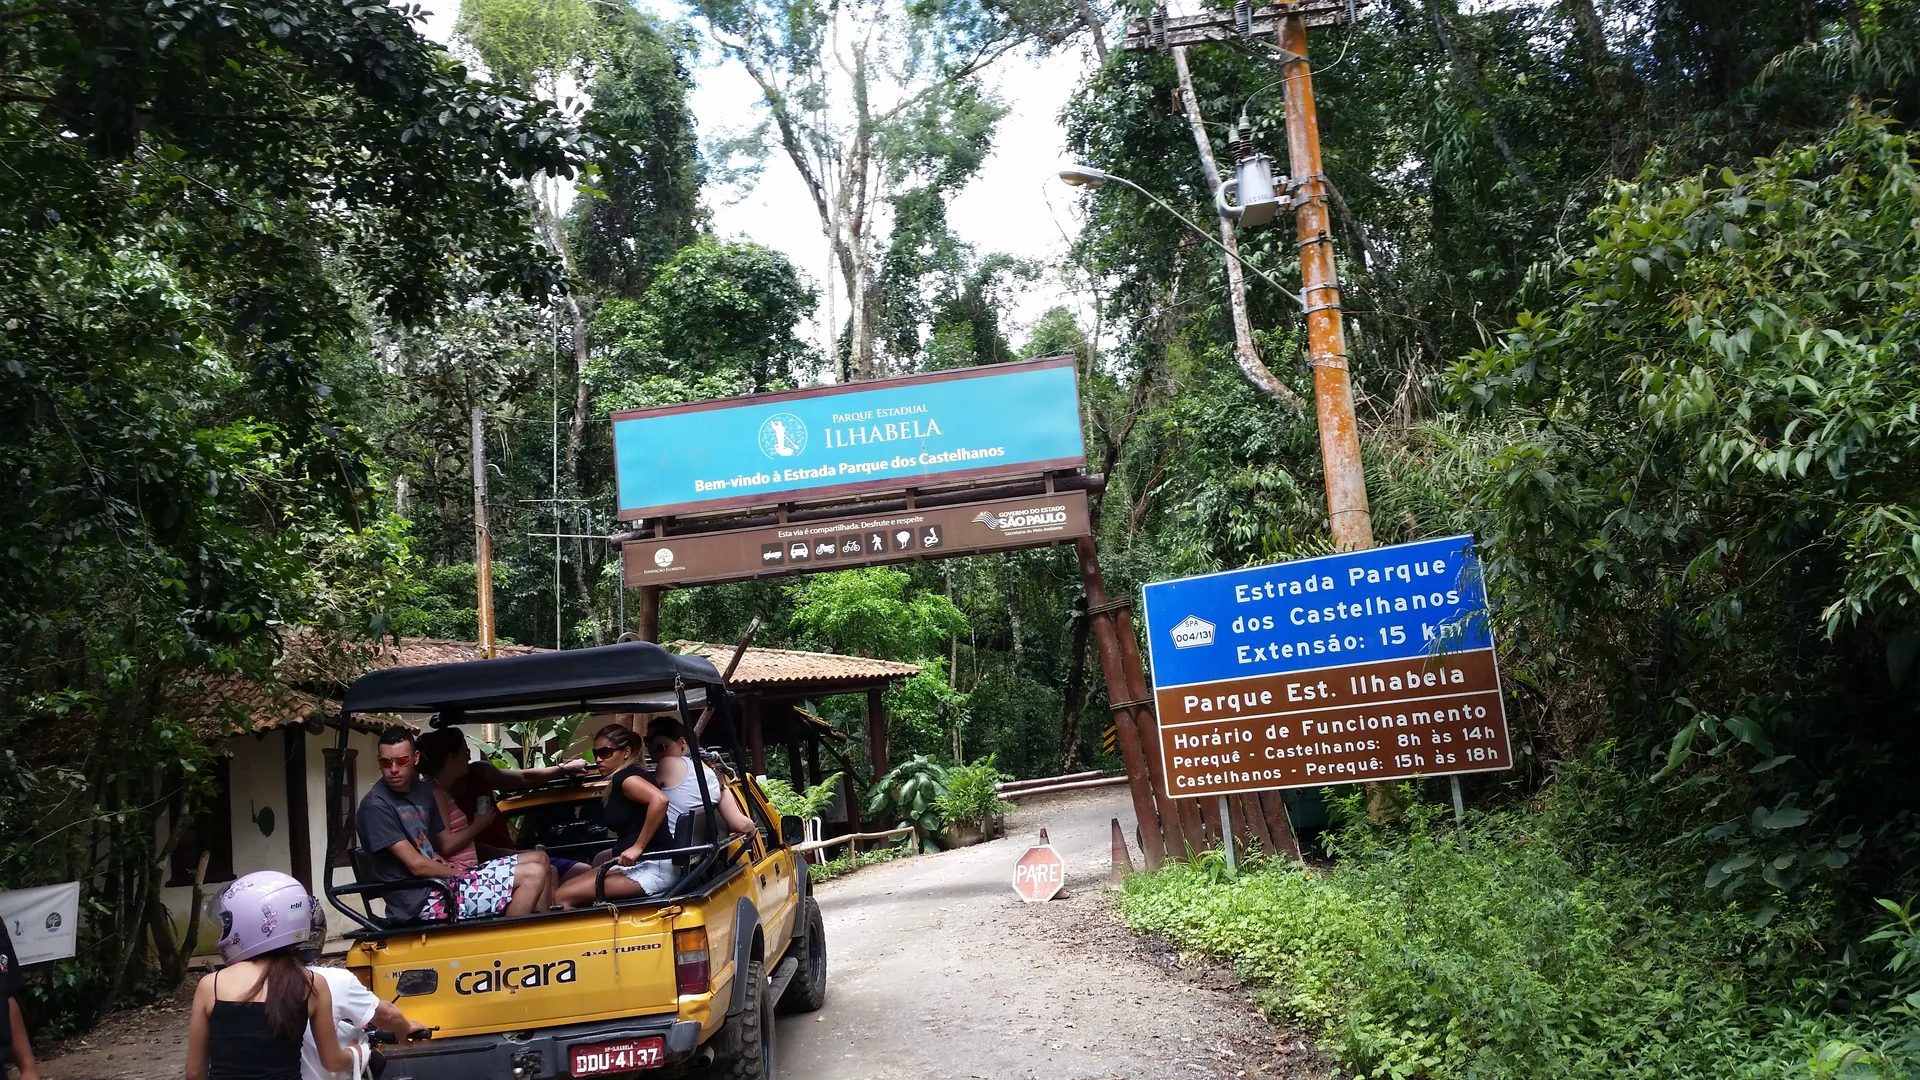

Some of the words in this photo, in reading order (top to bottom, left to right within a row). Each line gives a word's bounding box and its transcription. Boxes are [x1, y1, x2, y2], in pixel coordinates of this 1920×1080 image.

[824, 418, 943, 448] ILHABELA
[695, 472, 770, 492] Bem-vindo
[773, 470, 781, 483] à
[784, 464, 836, 481] Estrada
[839, 458, 888, 475] Parque
[891, 456, 917, 469] dos
[919, 446, 1005, 465] Castelhanos
[778, 529, 792, 537] Esta
[793, 528, 804, 536] via
[810, 522, 860, 534] compartilhada.
[861, 519, 890, 529] Desfrute
[896, 515, 924, 526] respeite
[998, 509, 1029, 517] GOVERNO
[1041, 505, 1065, 513] ESTADO
[999, 515, 1024, 528] SÃO
[1026, 512, 1066, 526] PAULO
[1235, 573, 1335, 603] Estrada
[1348, 559, 1446, 586] Parque
[1184, 619, 1199, 628] SPA
[1231, 615, 1275, 634] dos
[1289, 589, 1460, 626] Castelhanos
[1175, 630, 1212, 643] 004/131
[1236, 633, 1365, 664] Extensão:
[1379, 625, 1407, 646] 15
[1183, 689, 1273, 714] Parque
[1286, 680, 1337, 702] Est.
[1350, 666, 1465, 695] Ilhabela
[1174, 727, 1253, 749] Horário
[1265, 724, 1290, 740] de
[1301, 703, 1487, 736] Funcionamento
[1173, 750, 1241, 769] Perequê
[1264, 739, 1381, 760] Castelhanos:
[1397, 733, 1421, 747] 8h
[1431, 729, 1452, 744] às
[1462, 726, 1495, 741] 14h
[1176, 767, 1282, 788] Castelhanos
[1305, 757, 1384, 776] Perequê:
[1394, 753, 1425, 768] 15h
[1435, 749, 1456, 764] às
[1466, 747, 1498, 762] 18h
[1016, 863, 1061, 884] PARE
[612, 943, 662, 954] TURBO
[454, 959, 577, 995] caiçara
